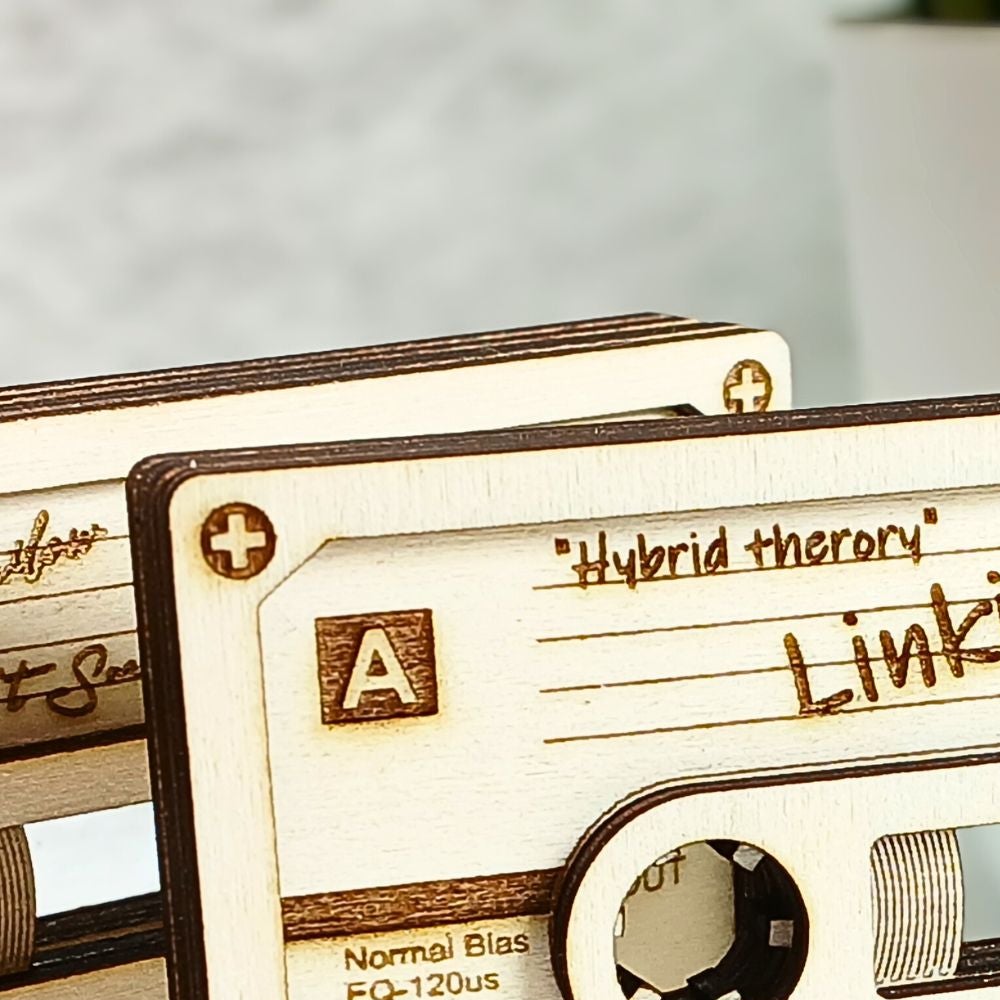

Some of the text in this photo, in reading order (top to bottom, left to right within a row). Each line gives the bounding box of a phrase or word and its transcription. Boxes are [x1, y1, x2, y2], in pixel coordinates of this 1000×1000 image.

[554, 525, 728, 589] "Hybrid
[343, 628, 420, 709] A
[344, 932, 454, 970] Normal
